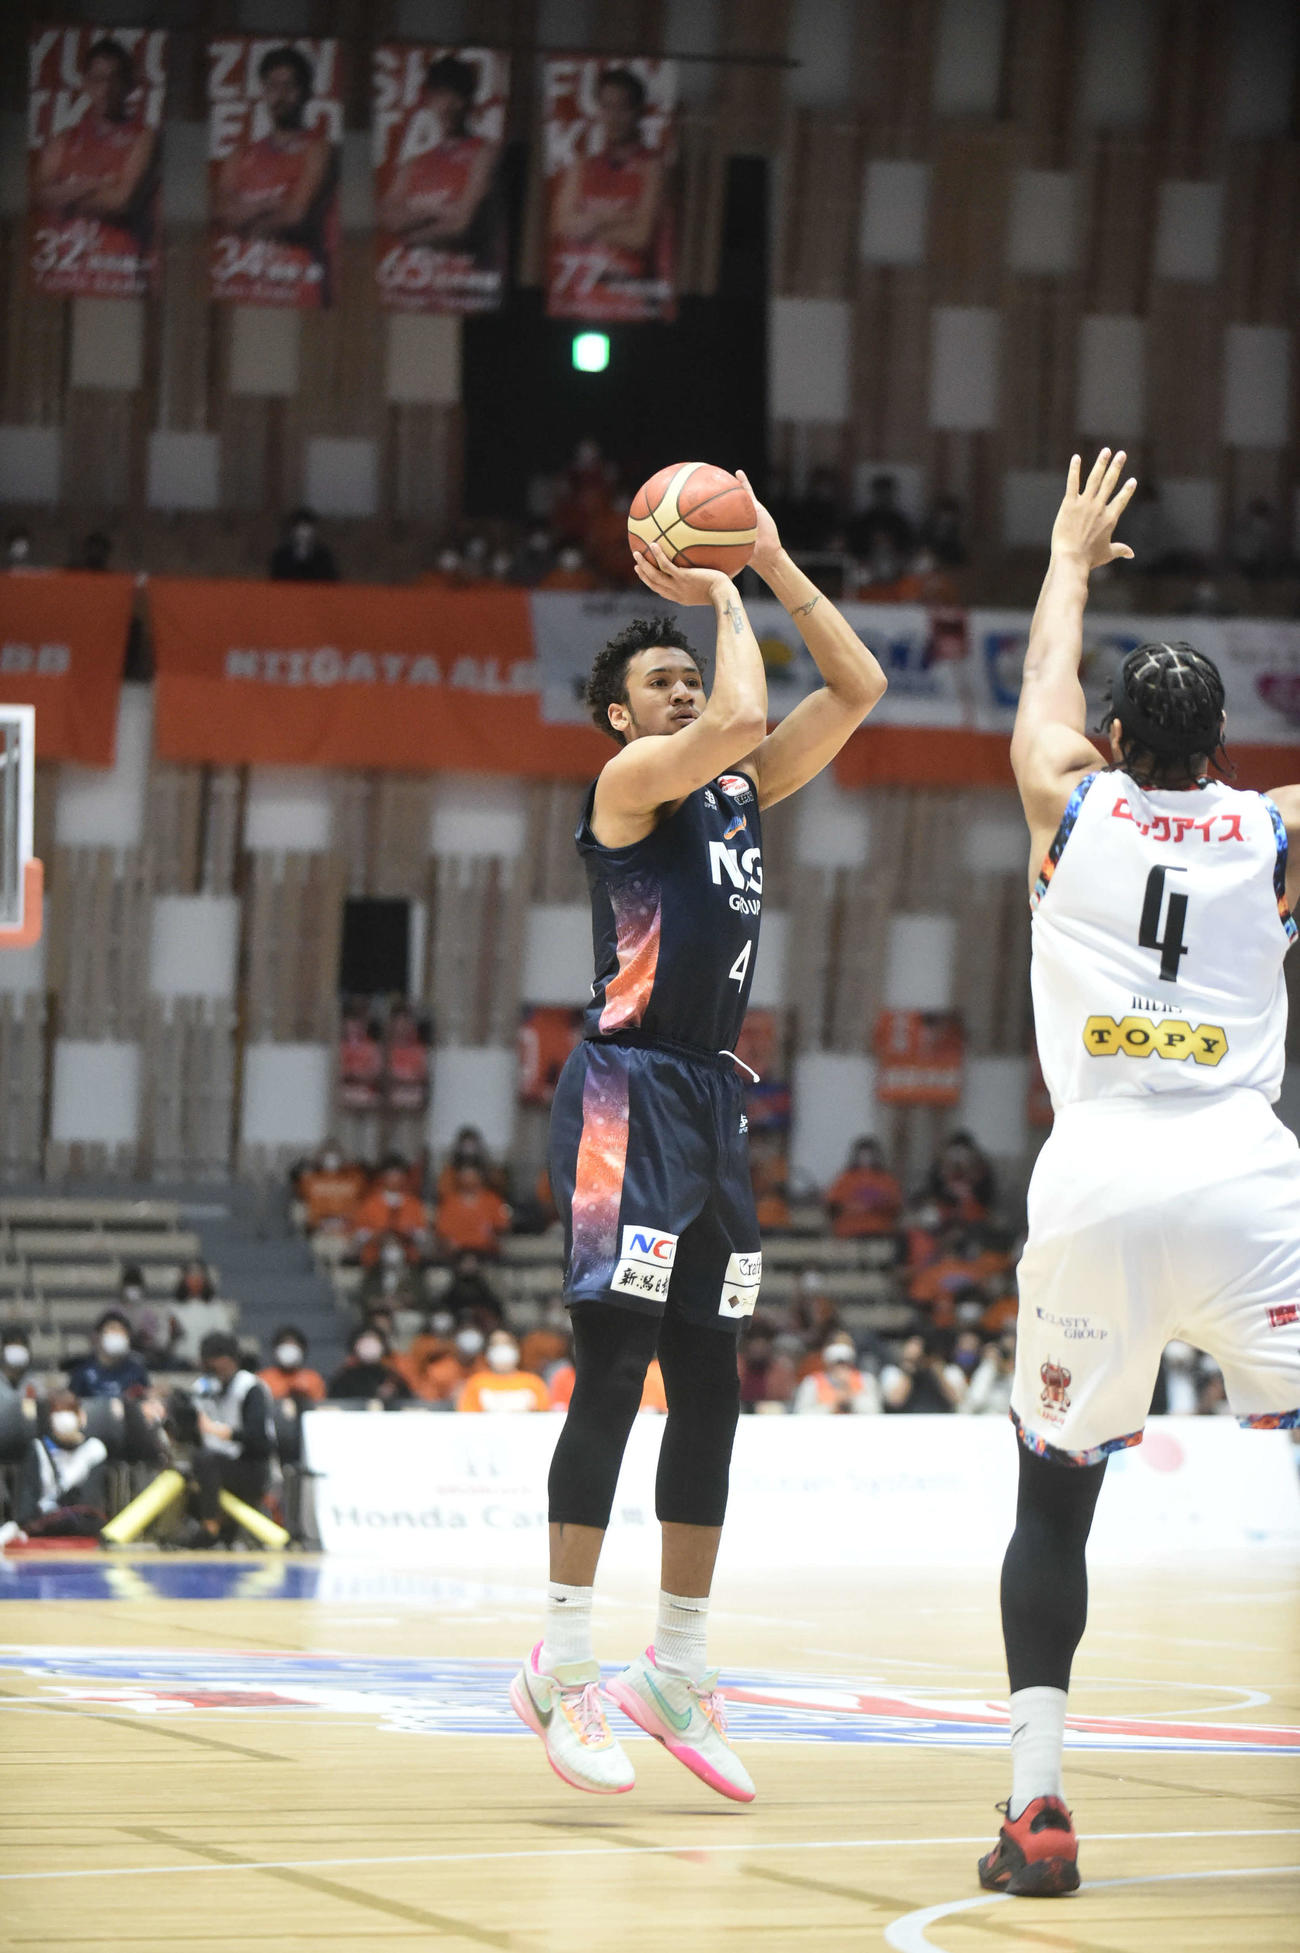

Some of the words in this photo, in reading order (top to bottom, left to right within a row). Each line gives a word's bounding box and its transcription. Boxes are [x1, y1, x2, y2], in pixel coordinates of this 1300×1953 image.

[1139, 864, 1188, 982] 4
[729, 940, 752, 993] 4
[1091, 1029, 1219, 1054] TOPY
[629, 1233, 675, 1260] NC
[331, 1504, 468, 1530] Honda
[480, 1504, 548, 1530] Car
